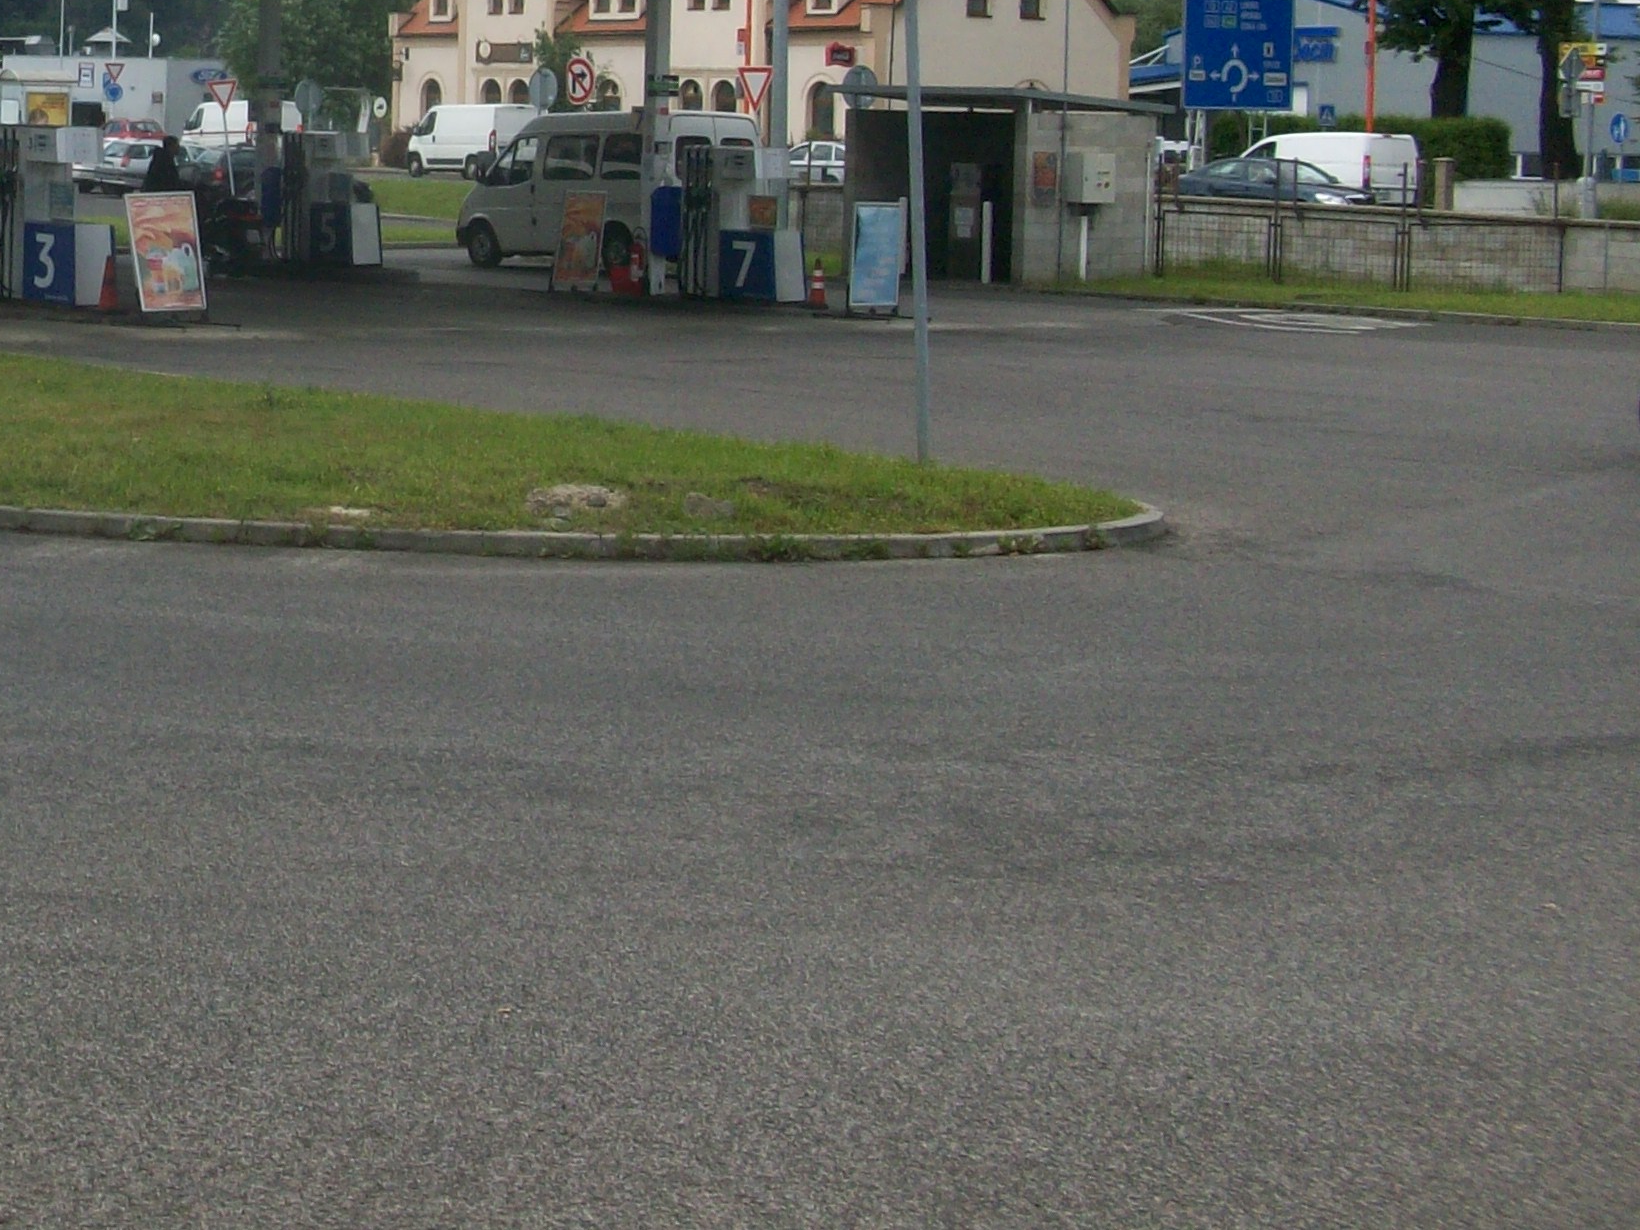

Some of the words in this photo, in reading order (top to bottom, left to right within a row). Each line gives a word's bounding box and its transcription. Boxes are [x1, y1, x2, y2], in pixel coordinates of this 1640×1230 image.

[319, 212, 337, 253] 5
[33, 231, 56, 289] 3
[731, 240, 757, 288] 7
